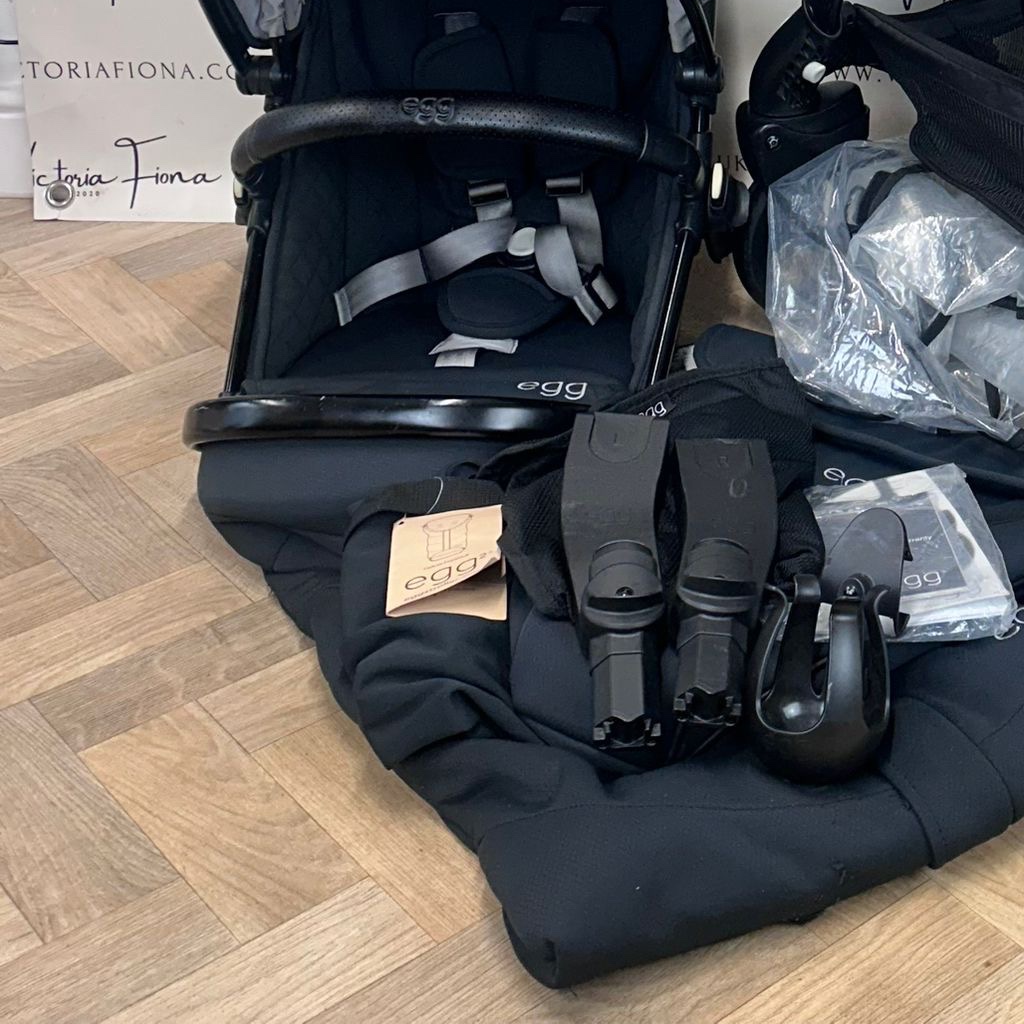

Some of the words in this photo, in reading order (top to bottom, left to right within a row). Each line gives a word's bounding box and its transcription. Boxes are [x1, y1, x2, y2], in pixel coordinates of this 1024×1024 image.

[401, 97, 455, 126] egg
[114, 135, 222, 209] Fiona
[517, 381, 588, 400] egg
